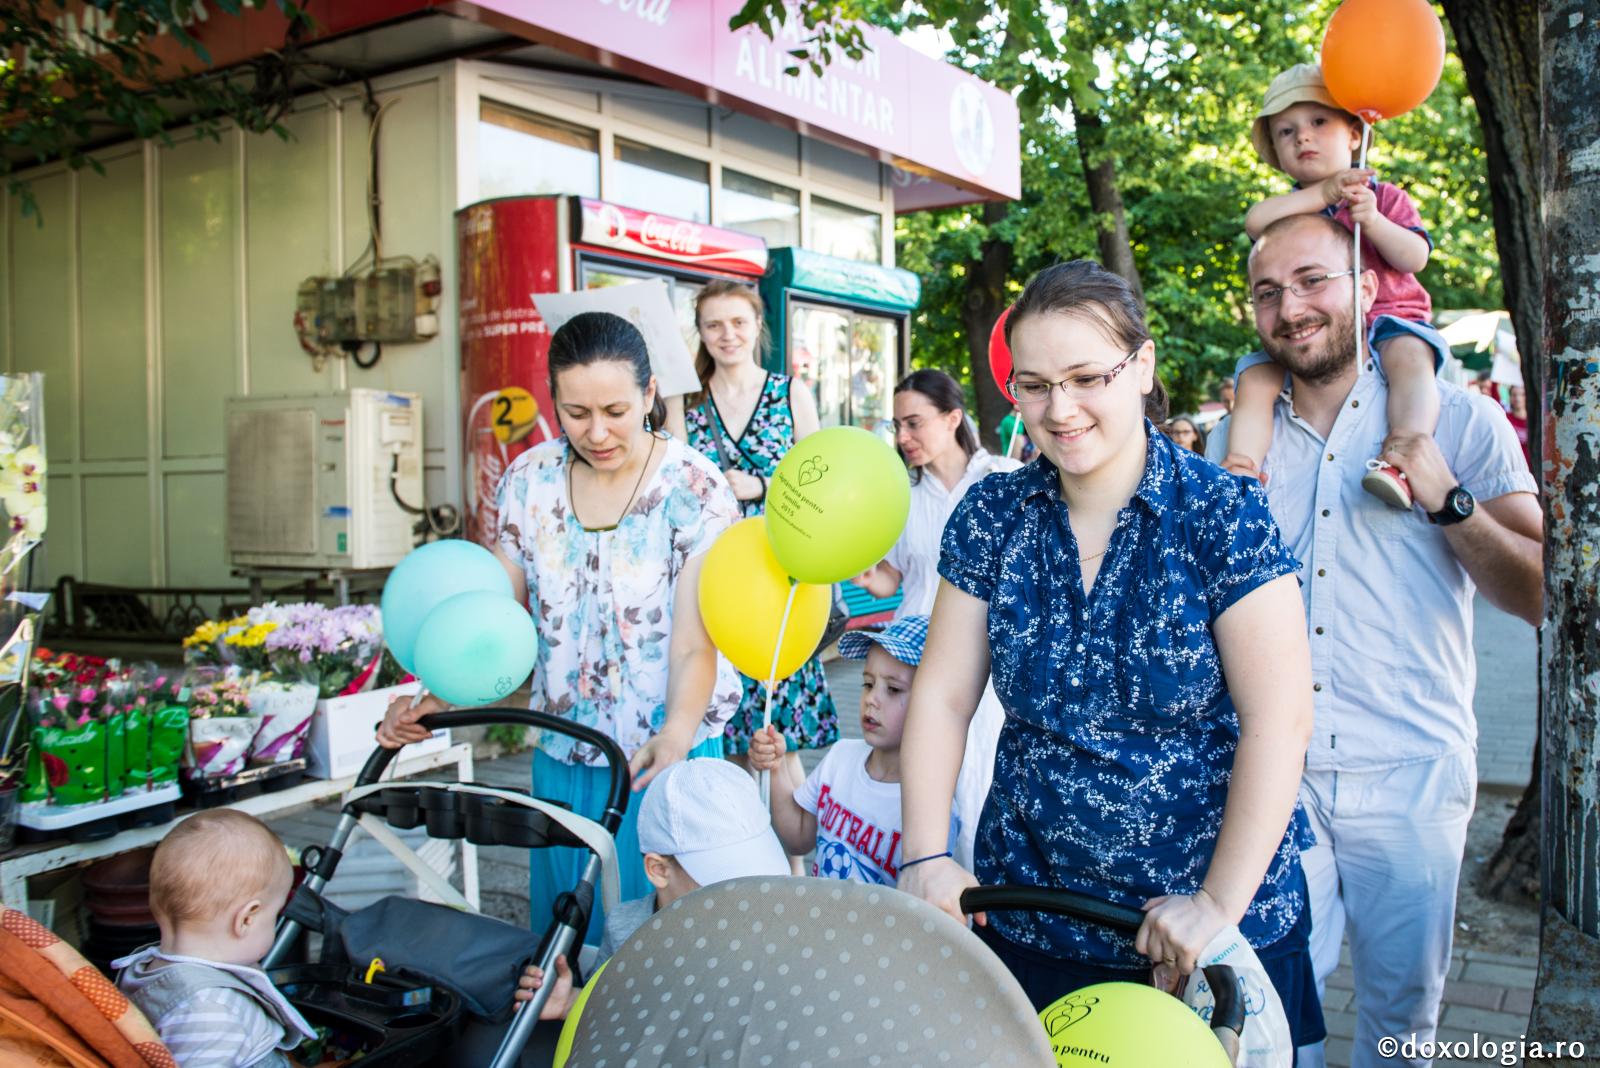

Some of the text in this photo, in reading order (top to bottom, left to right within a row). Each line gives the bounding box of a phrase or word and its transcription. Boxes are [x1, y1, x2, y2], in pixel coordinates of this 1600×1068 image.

[735, 37, 895, 136] ALIMENTAR
[484, 322, 518, 337] SUPER
[495, 396, 513, 426] 2
[781, 502, 795, 517] 2015
[800, 495, 824, 515] pentru
[817, 784, 901, 879] FOOTBALL
[1060, 1045, 1110, 1064] pentru
